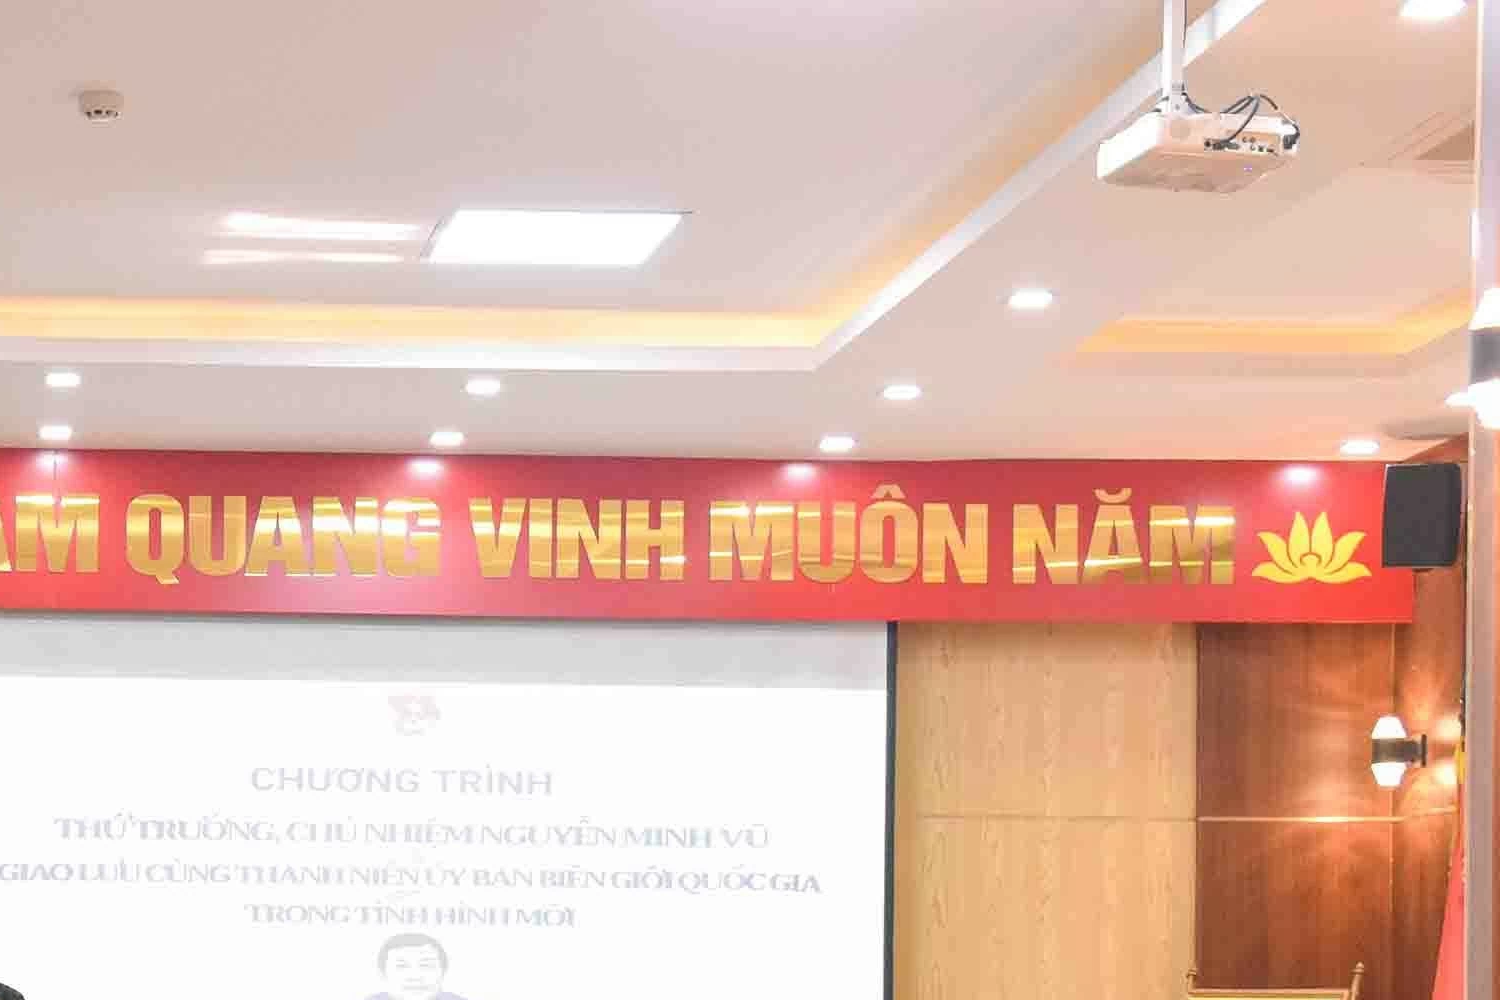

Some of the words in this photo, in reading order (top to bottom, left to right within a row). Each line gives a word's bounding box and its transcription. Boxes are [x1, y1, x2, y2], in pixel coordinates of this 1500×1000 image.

[125, 493, 443, 584] QUANG
[468, 497, 686, 582] VINH
[709, 484, 989, 585] MUÔN
[1012, 487, 1235, 585] NĂM
[250, 766, 421, 793] CHƯƠNG
[431, 762, 554, 796] TRÌNH
[622, 825, 713, 848] MINH
[145, 857, 231, 883] CÙNG
[234, 864, 343, 885] THANH
[472, 867, 533, 887] BAN
[677, 864, 768, 894] QUỐC
[770, 873, 823, 893] GIA
[244, 904, 350, 924] TRONG
[353, 898, 429, 925] TÌNH
[435, 900, 509, 926] HÌNH
